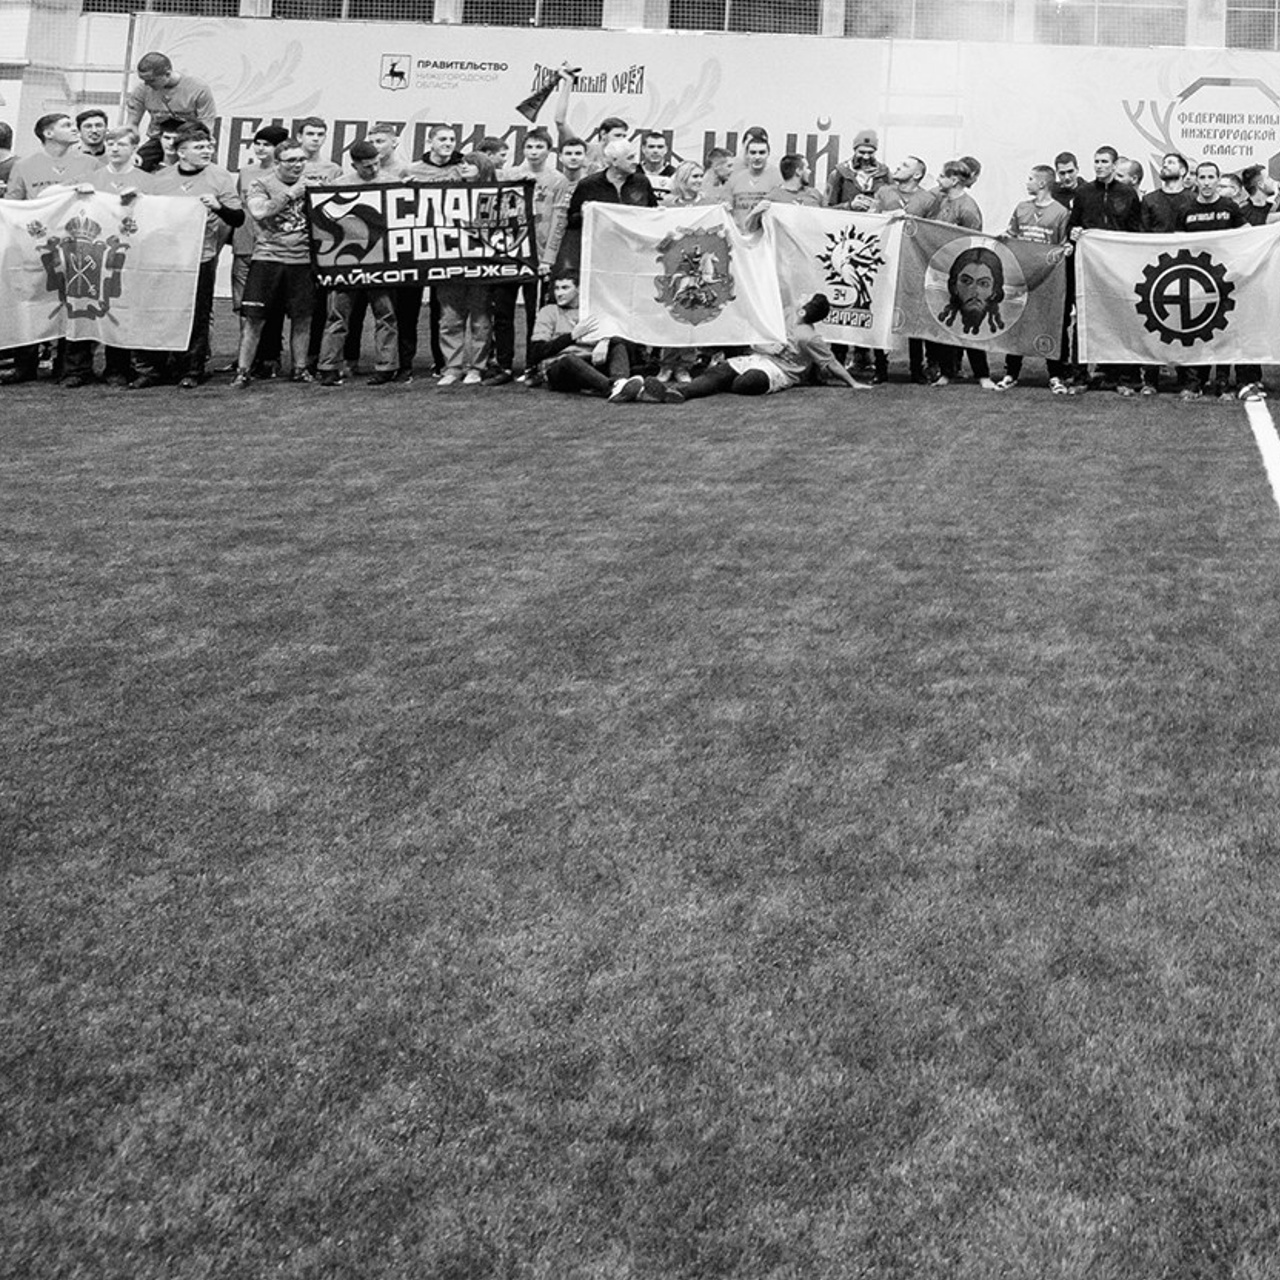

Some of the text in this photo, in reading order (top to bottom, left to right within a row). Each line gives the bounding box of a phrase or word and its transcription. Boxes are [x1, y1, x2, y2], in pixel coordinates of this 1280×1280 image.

[417, 60, 509, 71] ПРАВИТЕЛЬСТВО
[1177, 112, 1280, 125] ФЕДЕРАЦИЯ КИЛЫ
[1181, 128, 1275, 141] НИЖЕГОРОДСКОЙ
[1203, 144, 1253, 156] ОБЛАСТИ
[427, 264, 535, 280] ДРУЖБА
[833, 288, 847, 301] 34
